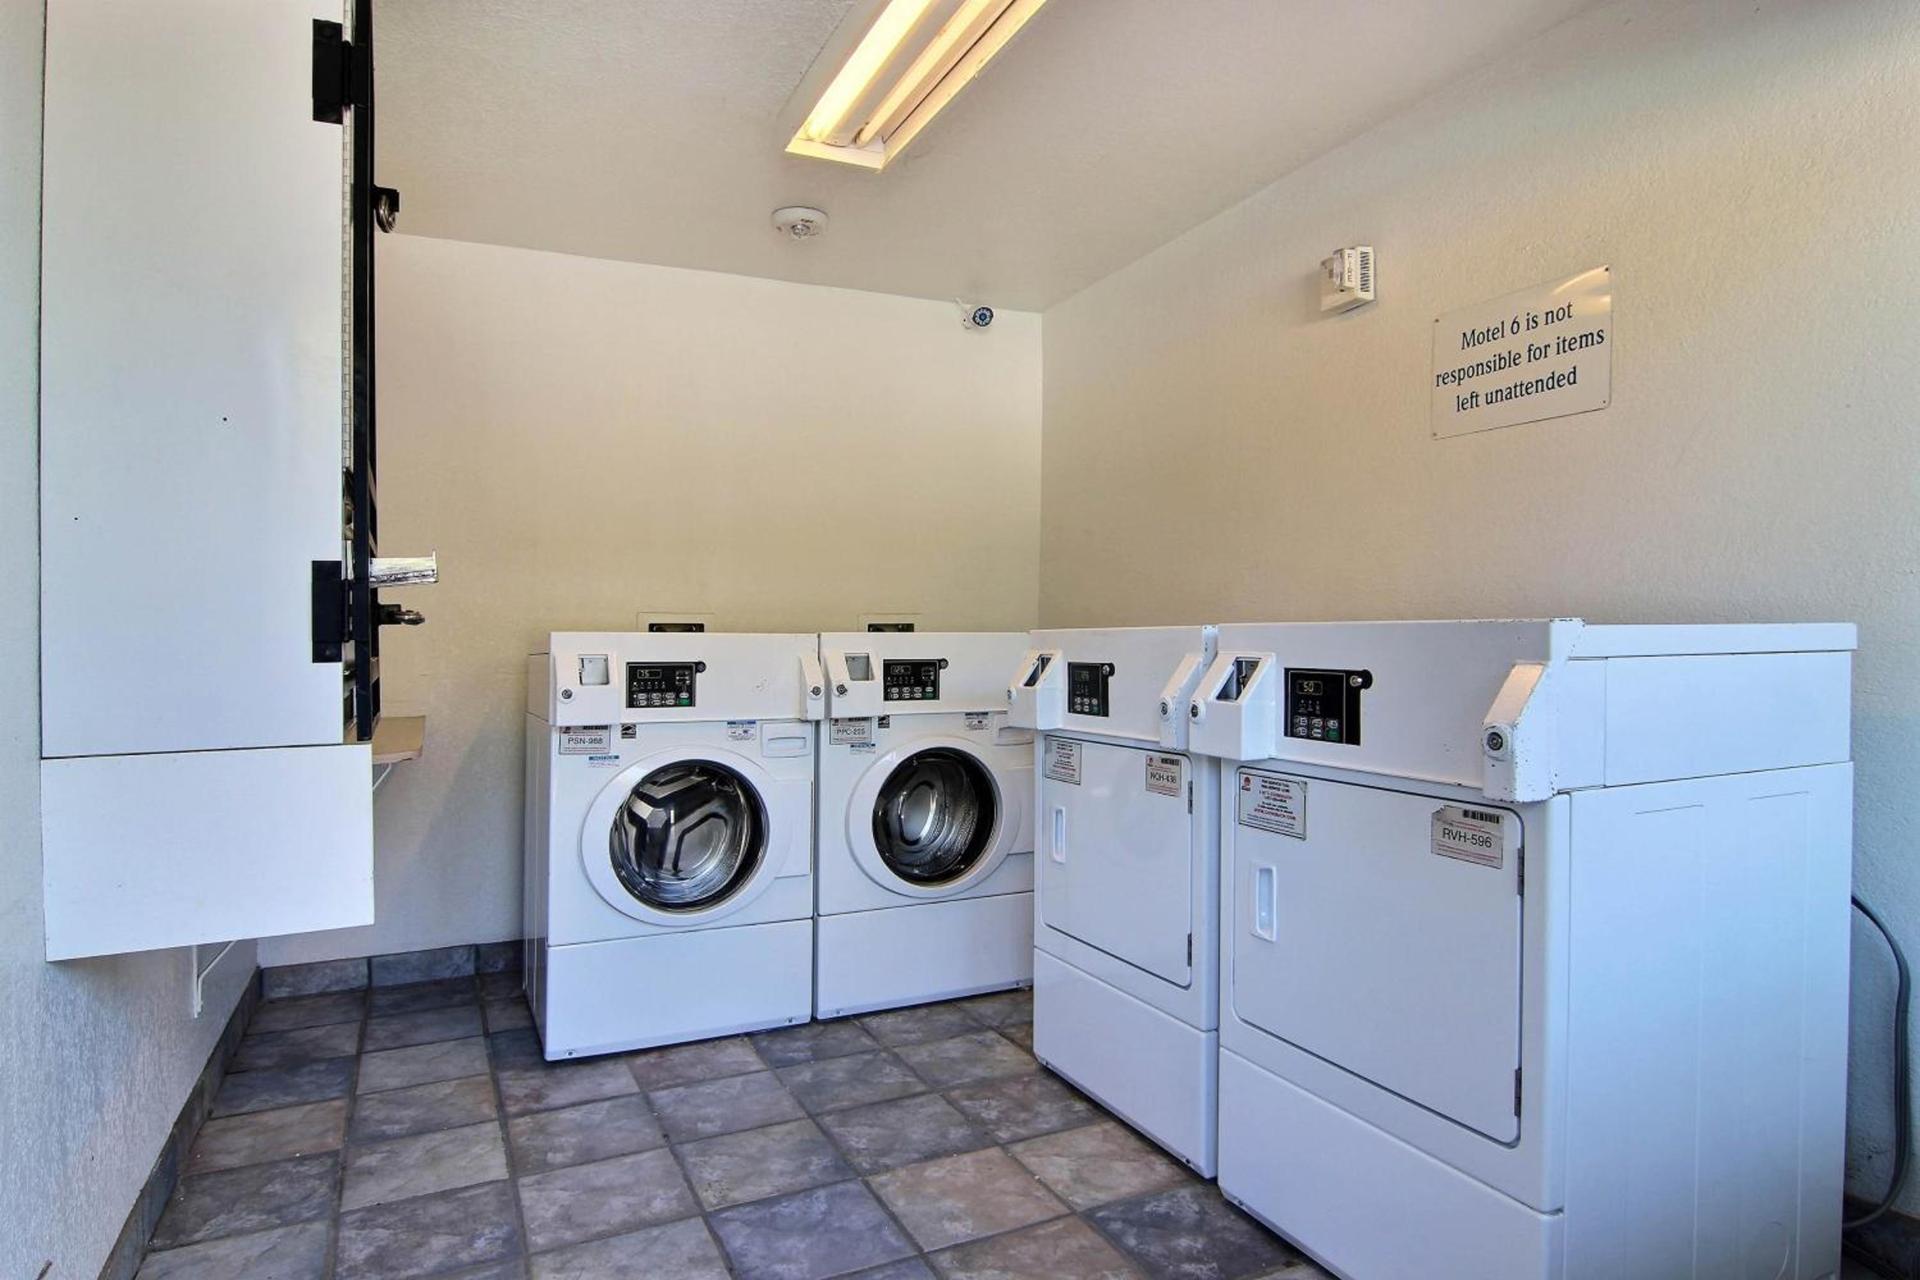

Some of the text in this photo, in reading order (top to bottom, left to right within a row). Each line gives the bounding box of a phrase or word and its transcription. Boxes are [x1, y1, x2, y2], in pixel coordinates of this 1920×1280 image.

[1461, 301, 1573, 350] Motel 6 is not
[1435, 328, 1606, 387] responsible for items
[1456, 366, 1578, 413] left unattended
[1442, 827, 1492, 848] RVH-596
